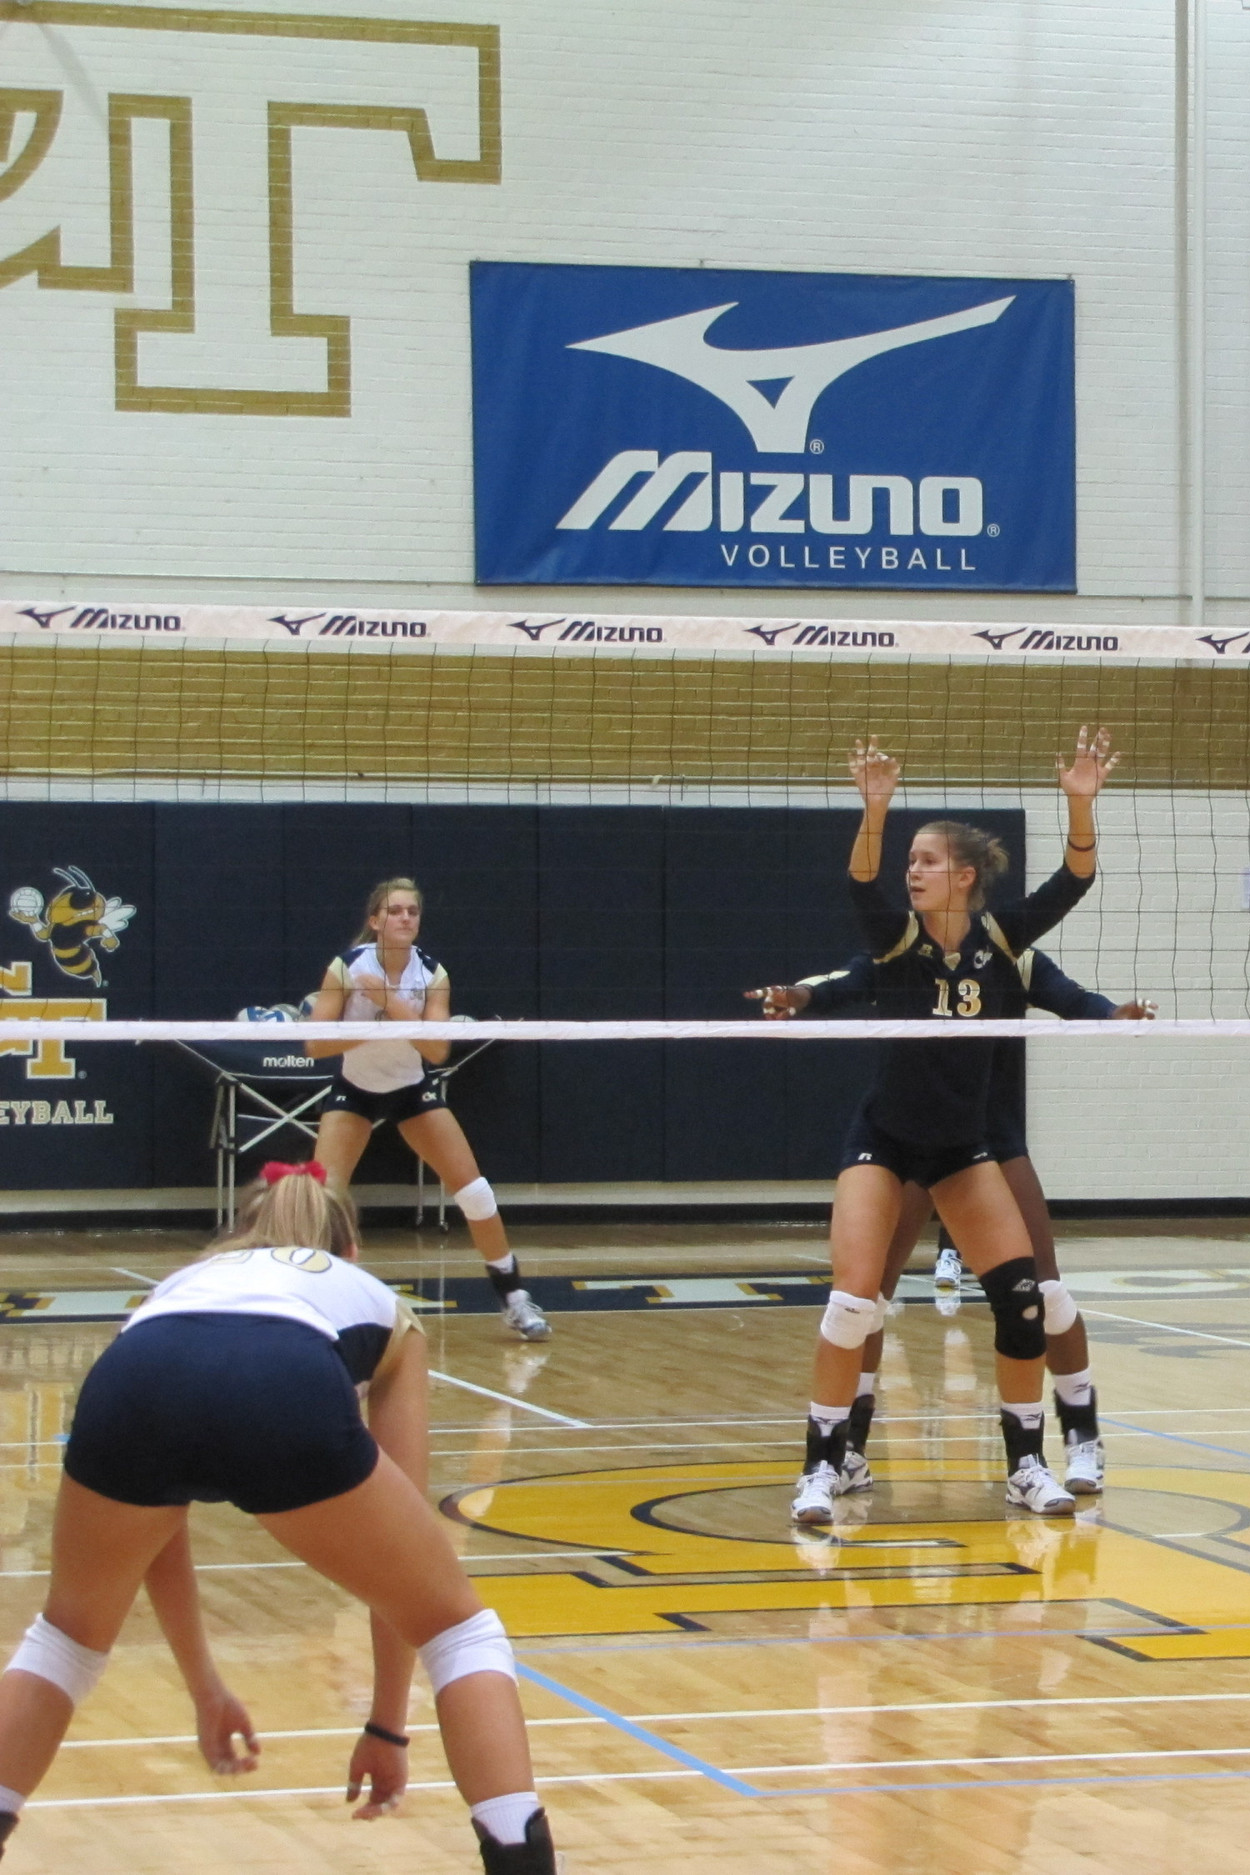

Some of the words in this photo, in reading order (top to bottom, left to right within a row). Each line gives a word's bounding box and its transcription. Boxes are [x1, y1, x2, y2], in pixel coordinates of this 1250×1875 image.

[556, 450, 983, 537] MIZUNO
[721, 544, 976, 571] VOLLEYBALL
[70, 608, 181, 631] MIZUNO
[317, 614, 427, 637] MIZUNO
[557, 619, 663, 642] MIZUNO
[791, 624, 895, 647] MIZUNO
[1018, 629, 1119, 651] MIZUNO
[932, 978, 982, 1017] 13
[263, 1055, 315, 1068] molten
